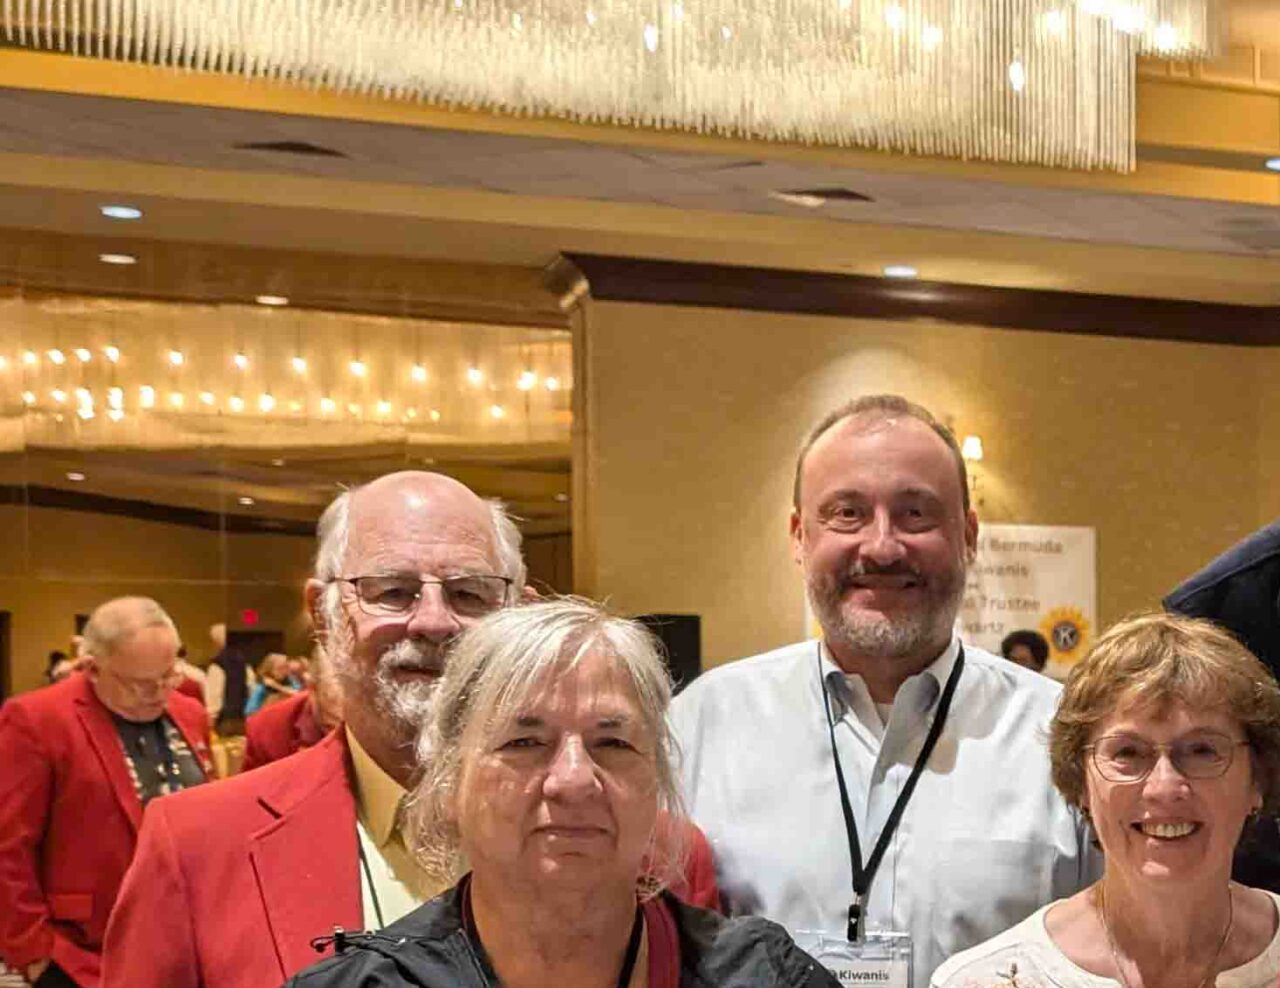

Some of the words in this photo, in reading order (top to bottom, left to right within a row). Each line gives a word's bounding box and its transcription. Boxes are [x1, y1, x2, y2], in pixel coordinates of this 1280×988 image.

[990, 539, 1063, 554] Bermuda
[978, 596, 1041, 611] Trustee
[839, 969, 890, 981] Kiwanis
